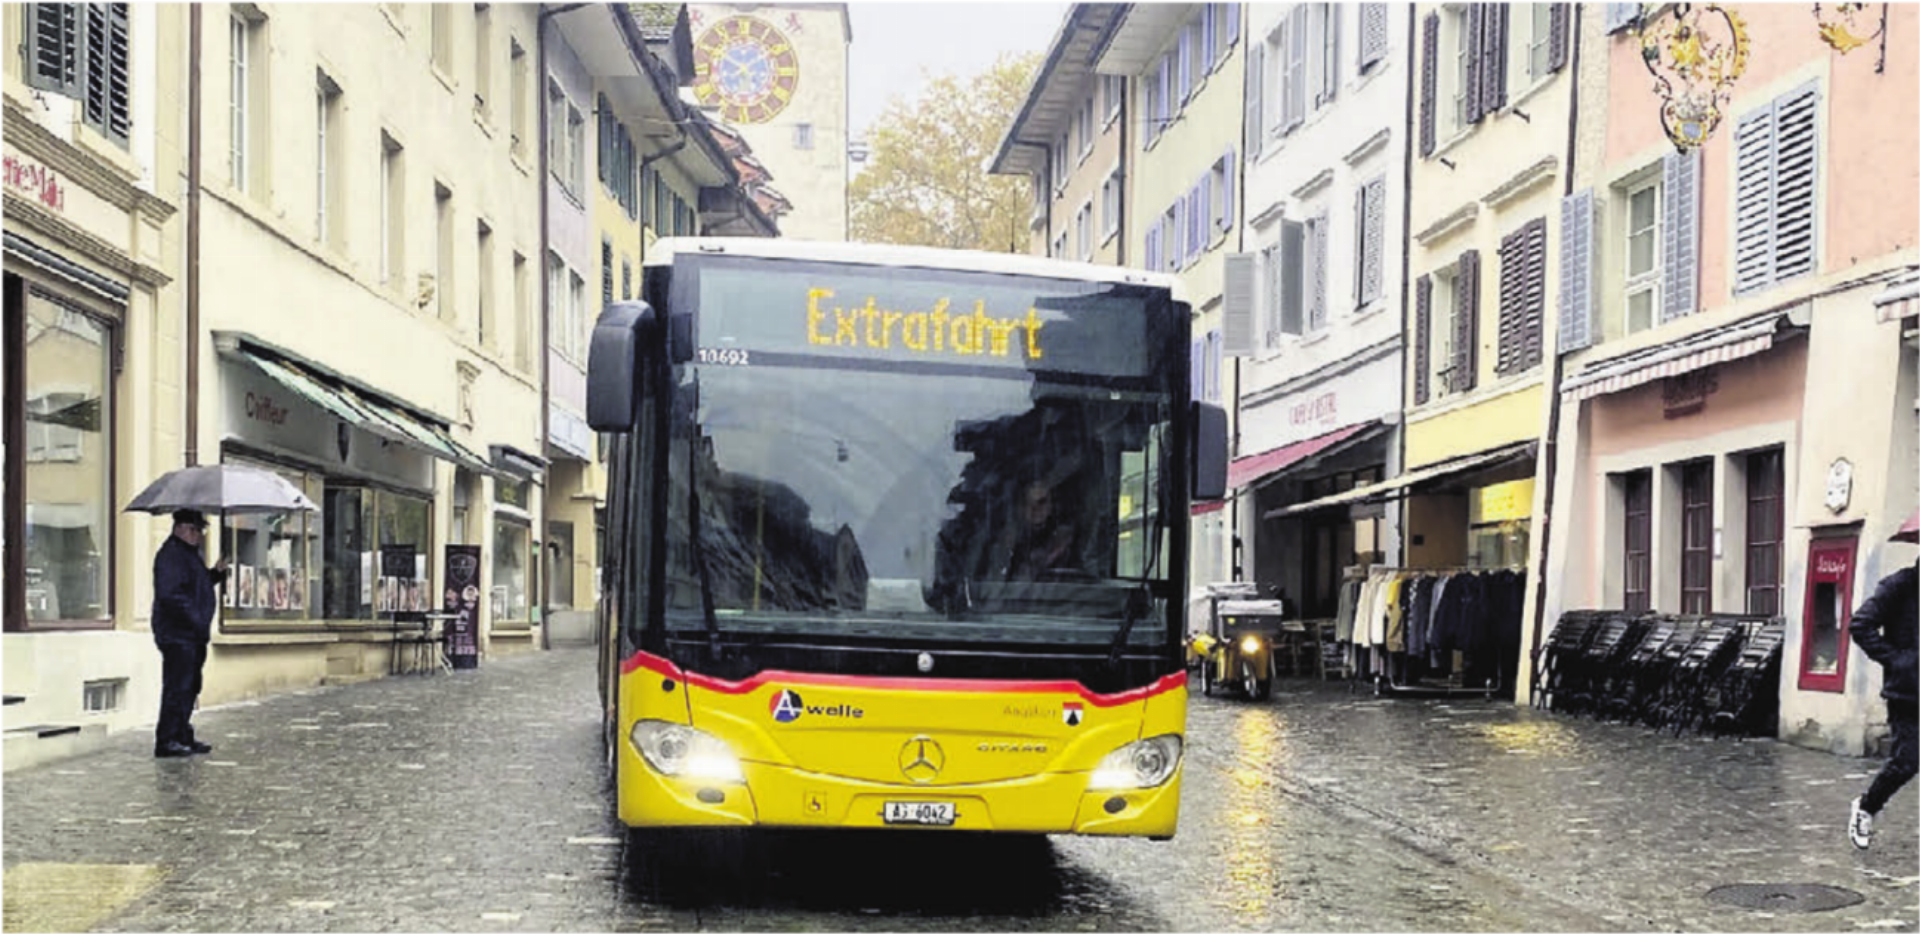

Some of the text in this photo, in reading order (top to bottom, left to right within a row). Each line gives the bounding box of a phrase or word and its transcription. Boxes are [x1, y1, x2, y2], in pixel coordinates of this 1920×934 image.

[807, 287, 1042, 359] Extrafahrt
[699, 349, 749, 366] 10692
[806, 704, 864, 718] welle
[915, 802, 947, 819] 6042
